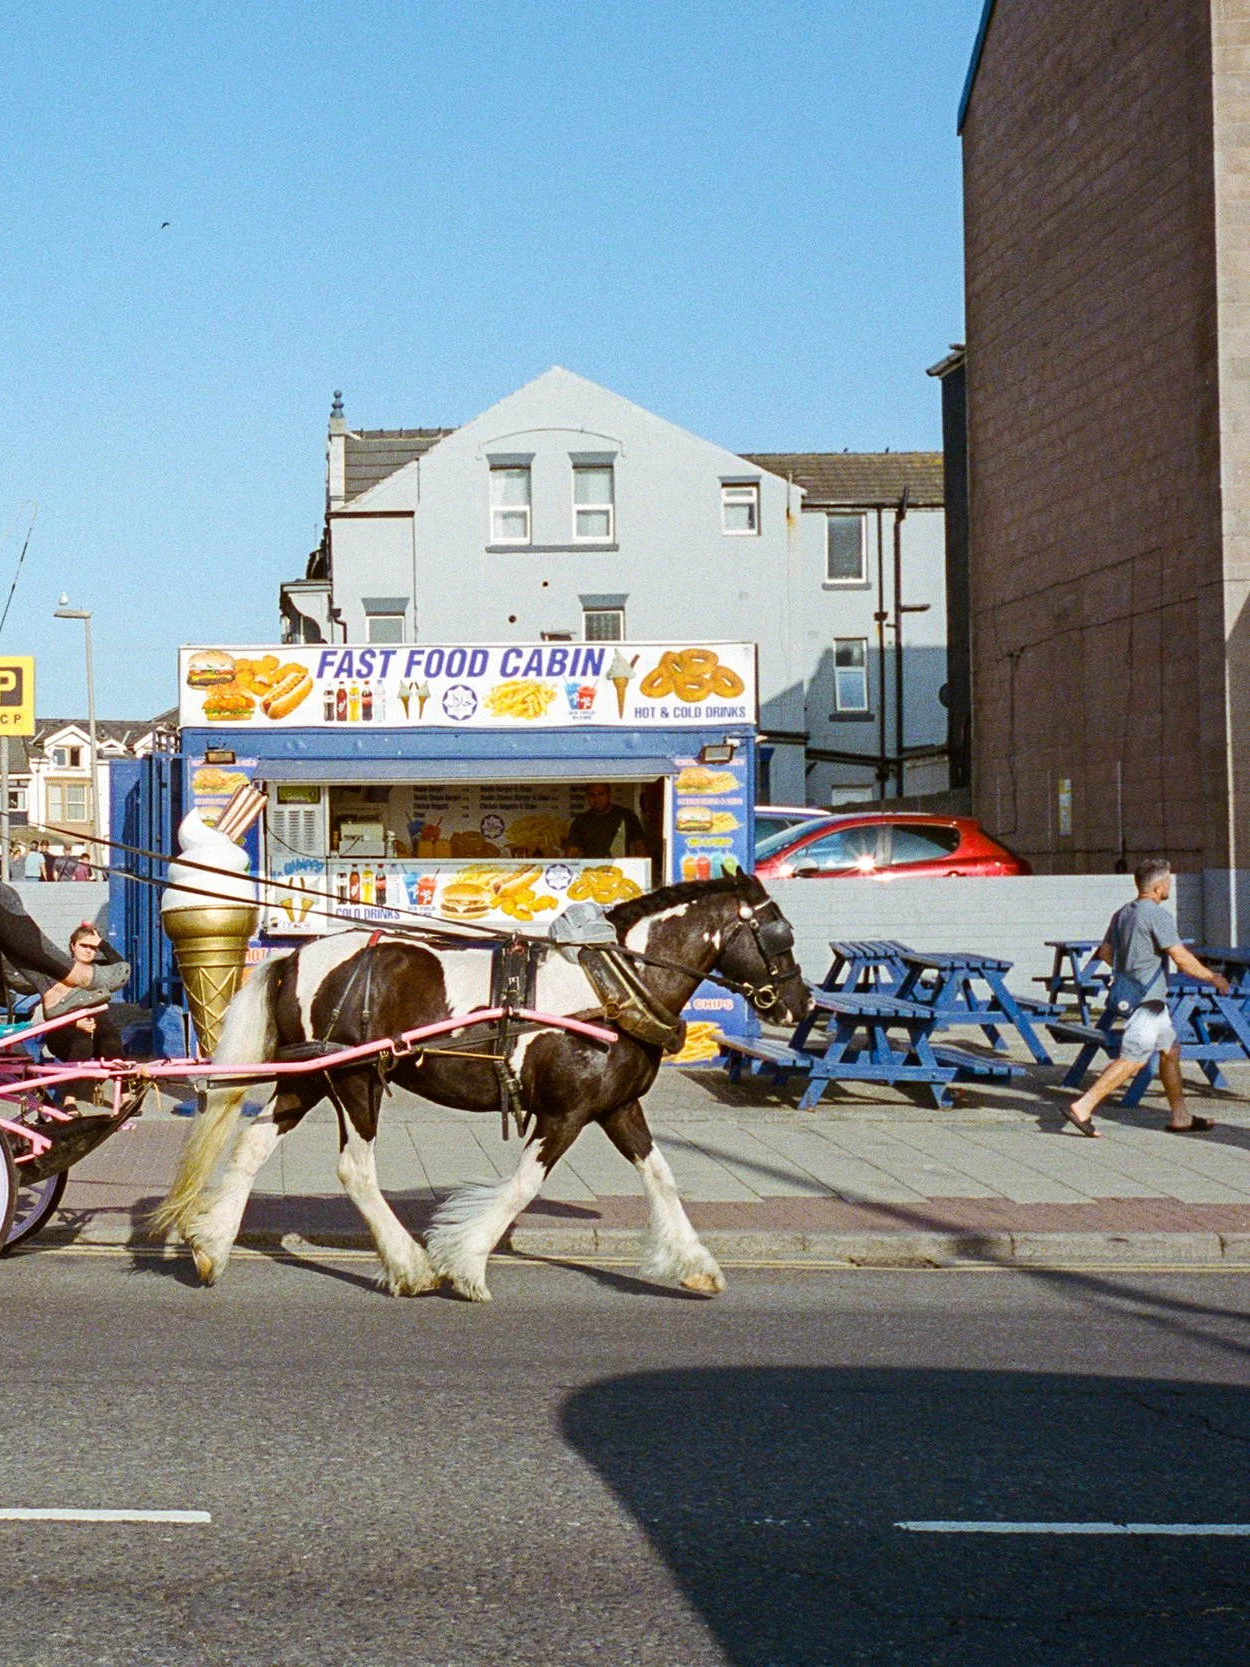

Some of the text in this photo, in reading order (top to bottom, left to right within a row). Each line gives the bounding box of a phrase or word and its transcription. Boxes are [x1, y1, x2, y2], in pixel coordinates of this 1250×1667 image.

[316, 647, 606, 679] FAST FOOD CABIN
[634, 706, 746, 719] HOT & COLD DRINKS
[336, 907, 361, 919] COLD
[364, 908, 401, 920] DRINKS
[694, 999, 733, 1010] CHIPS
